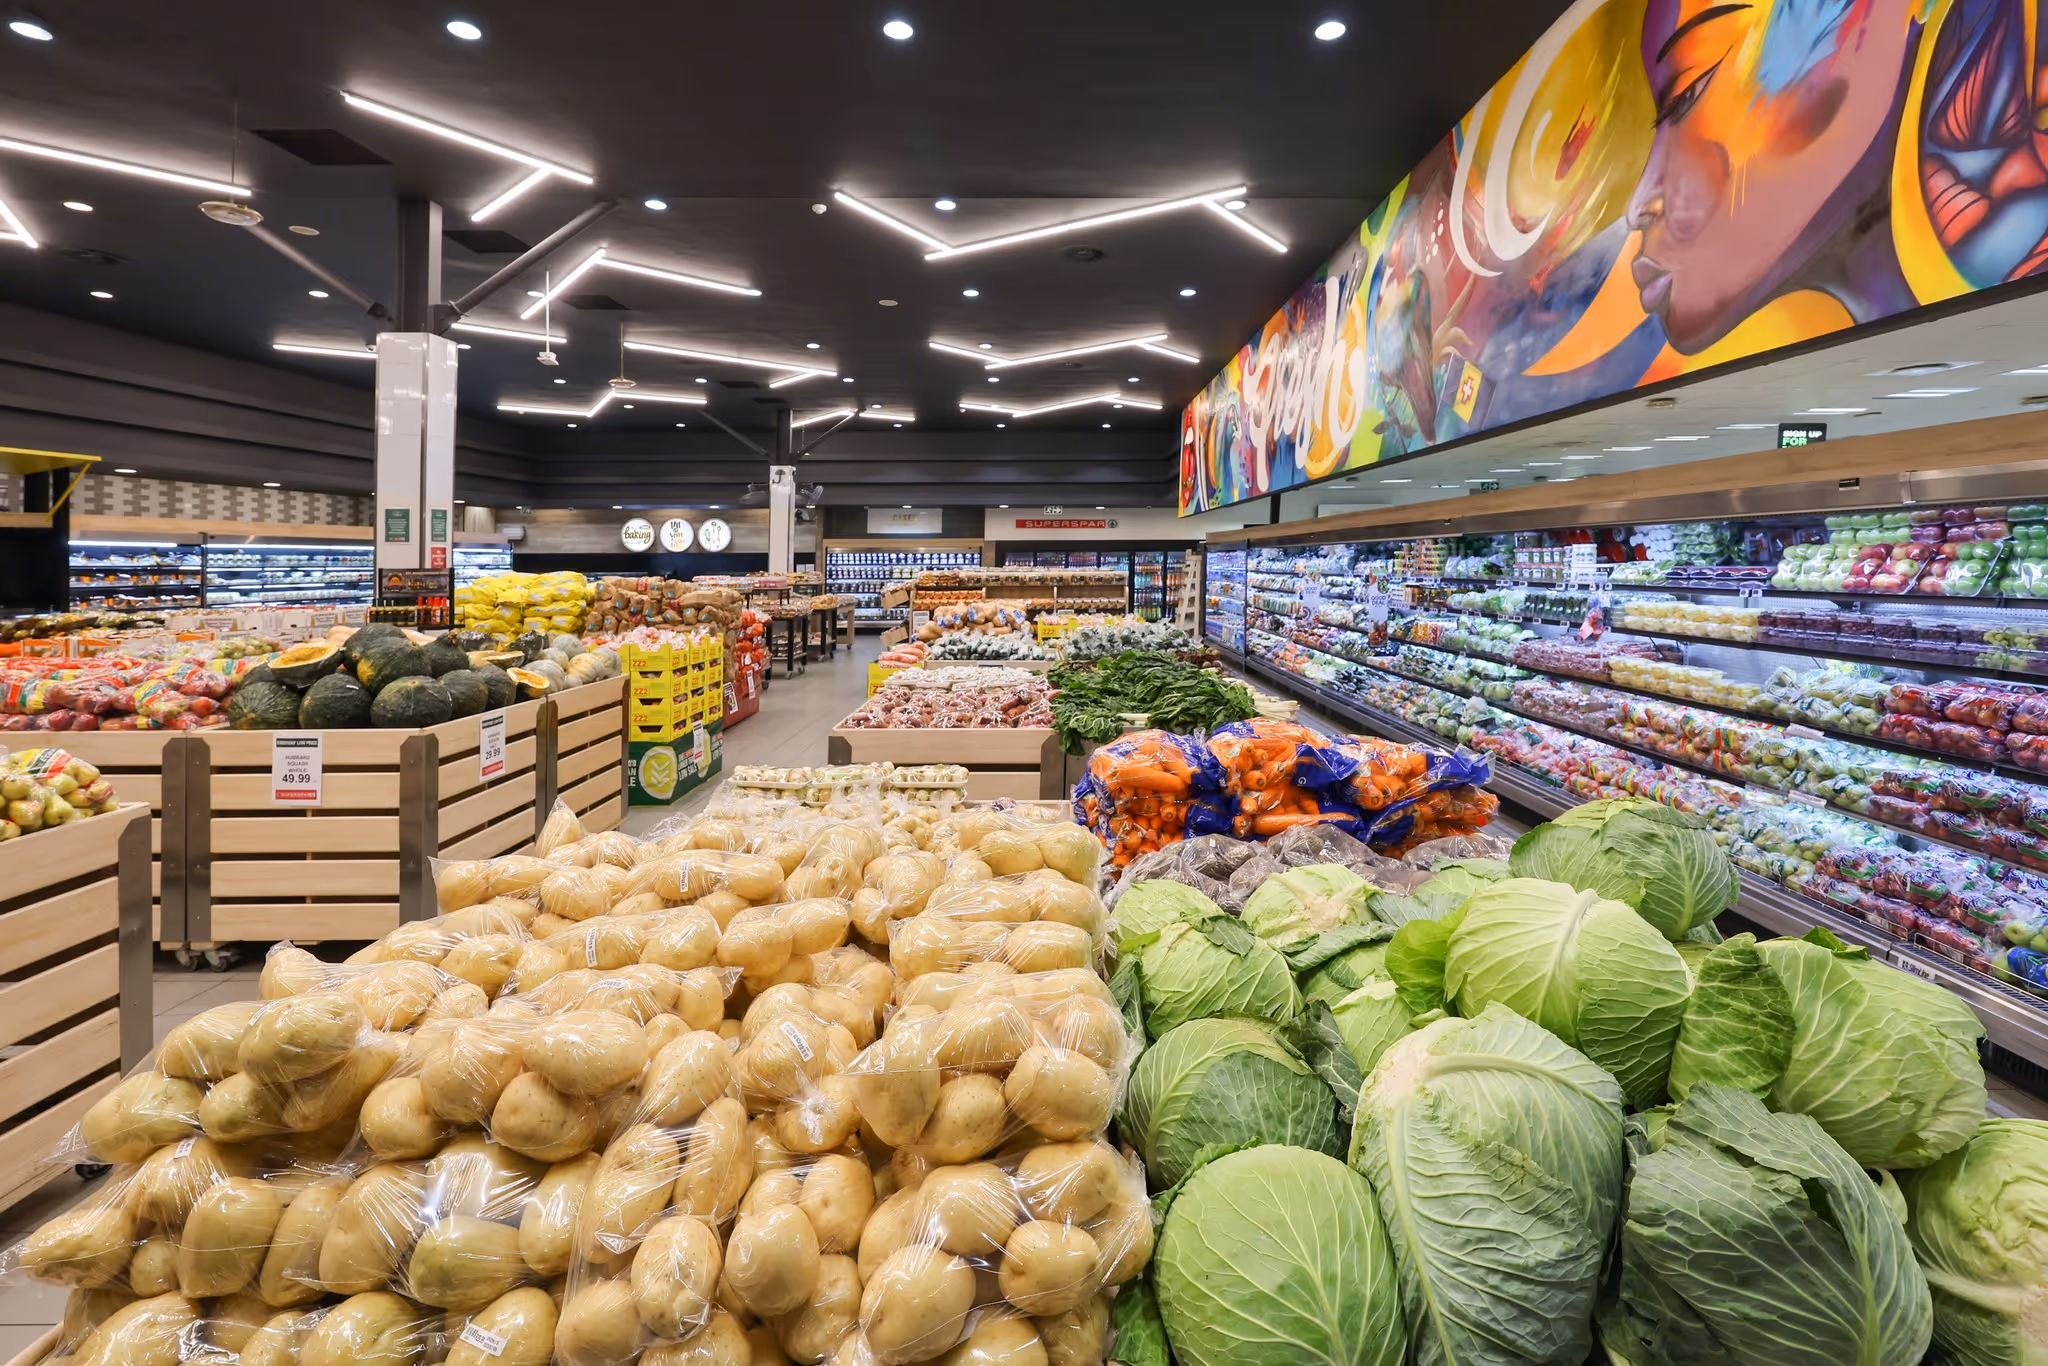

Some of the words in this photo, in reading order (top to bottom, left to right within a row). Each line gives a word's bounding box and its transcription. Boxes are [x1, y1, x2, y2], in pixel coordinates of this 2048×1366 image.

[1808, 430, 1822, 438] UP
[1783, 437, 1808, 446] FOR
[624, 526, 652, 544] baking
[632, 660, 647, 668] ZZ2
[485, 747, 501, 760] 29.99
[282, 773, 311, 784] 49.99
